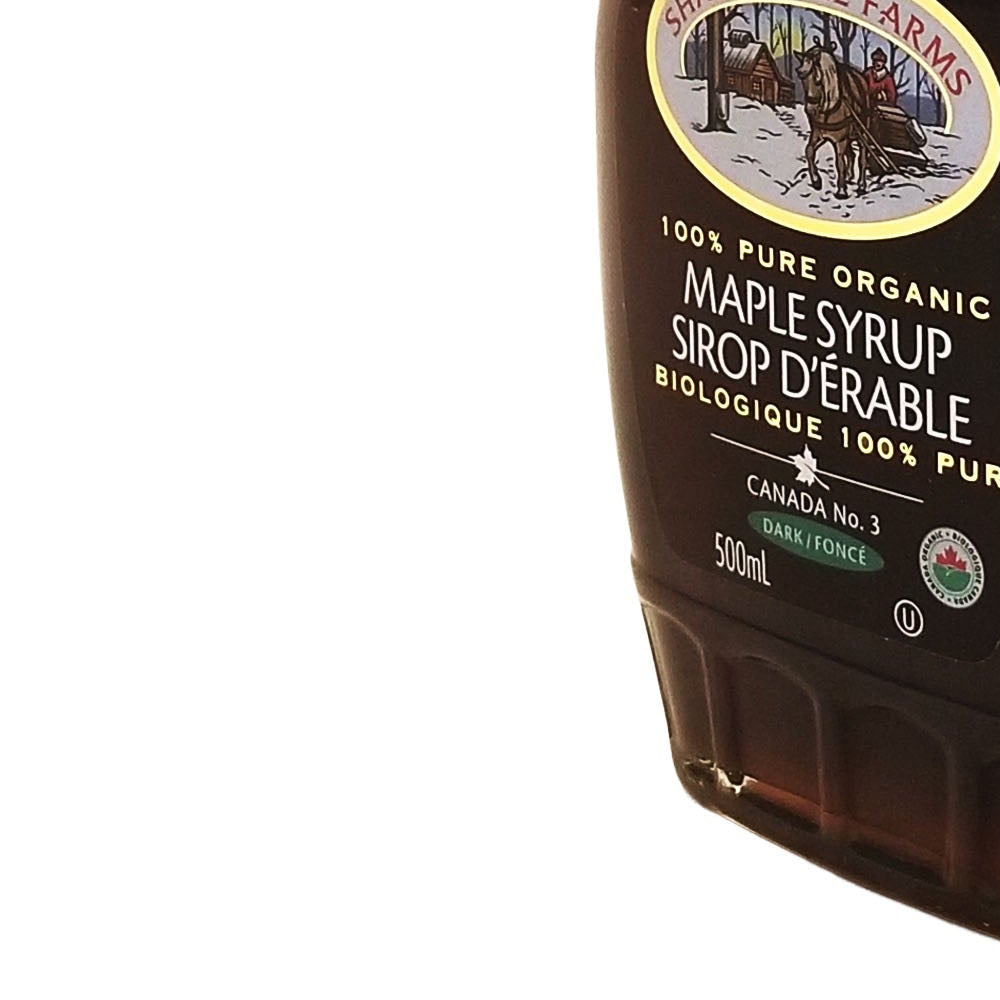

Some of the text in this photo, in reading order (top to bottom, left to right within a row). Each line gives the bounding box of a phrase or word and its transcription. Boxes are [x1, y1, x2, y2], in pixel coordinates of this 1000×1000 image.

[661, 216, 991, 320] 100% PURE ORGANIC
[672, 314, 770, 386] SIROP
[684, 260, 952, 376] MAPLE SYRUP
[655, 363, 823, 440] BIOLOGIQUE
[841, 426, 917, 467] 100%
[747, 474, 880, 535] CANADA No. 3
[715, 532, 771, 586] 500mL
